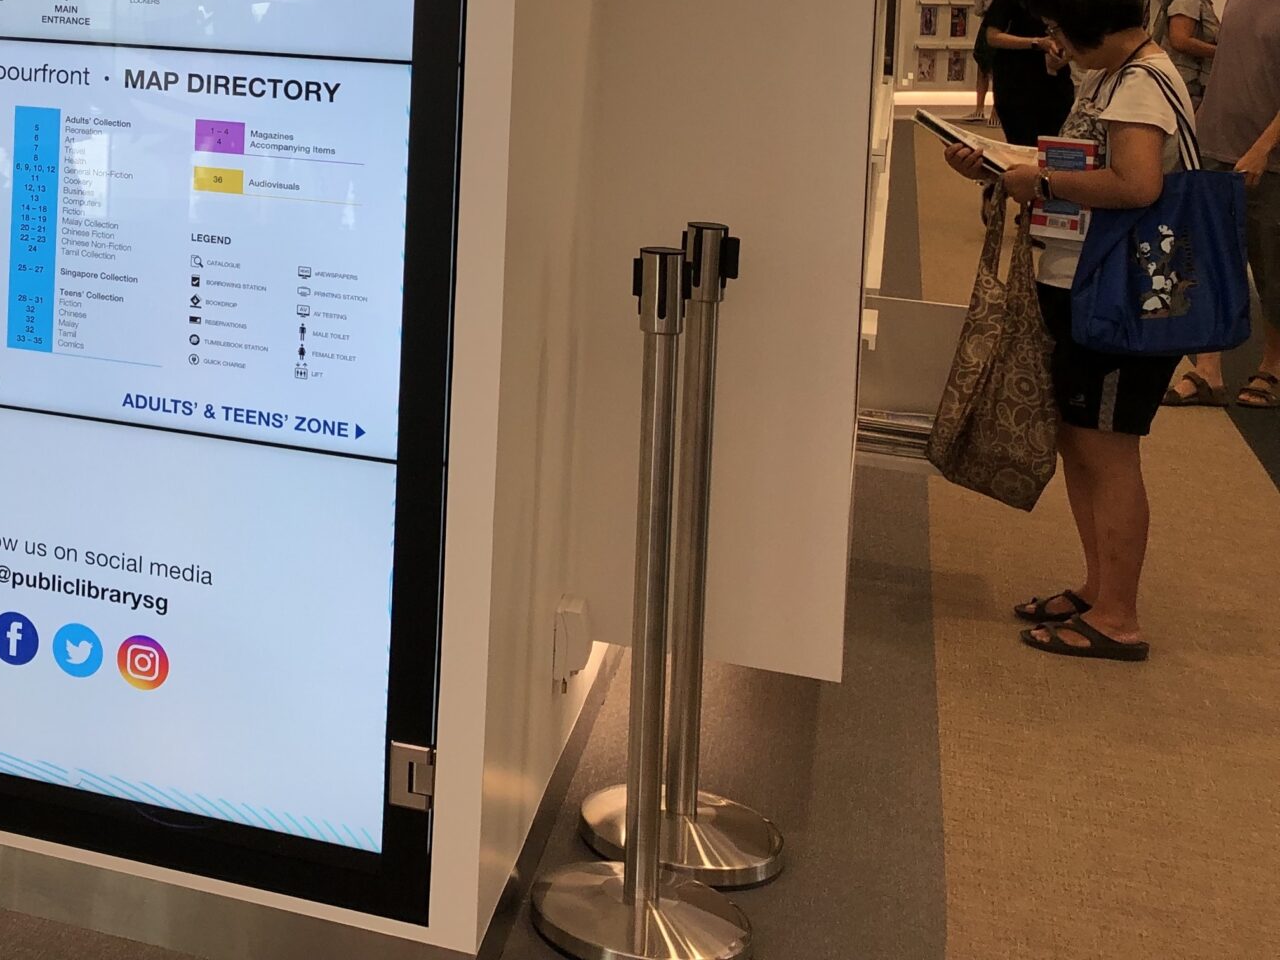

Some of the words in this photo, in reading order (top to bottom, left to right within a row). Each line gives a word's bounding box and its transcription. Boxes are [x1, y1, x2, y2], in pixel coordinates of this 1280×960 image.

[54, 5, 78, 13] MAIN
[41, 16, 91, 26] ENTRANCE
[124, 69, 179, 91] MAP
[187, 73, 341, 103] DIRECTORY
[65, 116, 91, 125] Adults'
[93, 118, 131, 128] Collection
[250, 130, 294, 141] Magazines
[250, 141, 310, 154] Accompanying
[313, 146, 336, 155] Items
[213, 176, 223, 184] 36
[248, 179, 300, 191] Audiovisuals
[191, 233, 232, 245] LEGEND
[60, 268, 99, 279] Singapore
[100, 272, 138, 283] Collection
[60, 289, 85, 298] Teens'
[86, 291, 124, 302] Collection
[122, 393, 198, 416] ADULTS'
[203, 403, 216, 420] &
[221, 406, 289, 429] TEENS'
[294, 416, 349, 438] ZONE
[24, 539, 47, 557] us
[53, 543, 78, 563] on
[84, 551, 143, 573] social
[149, 561, 213, 586] media
